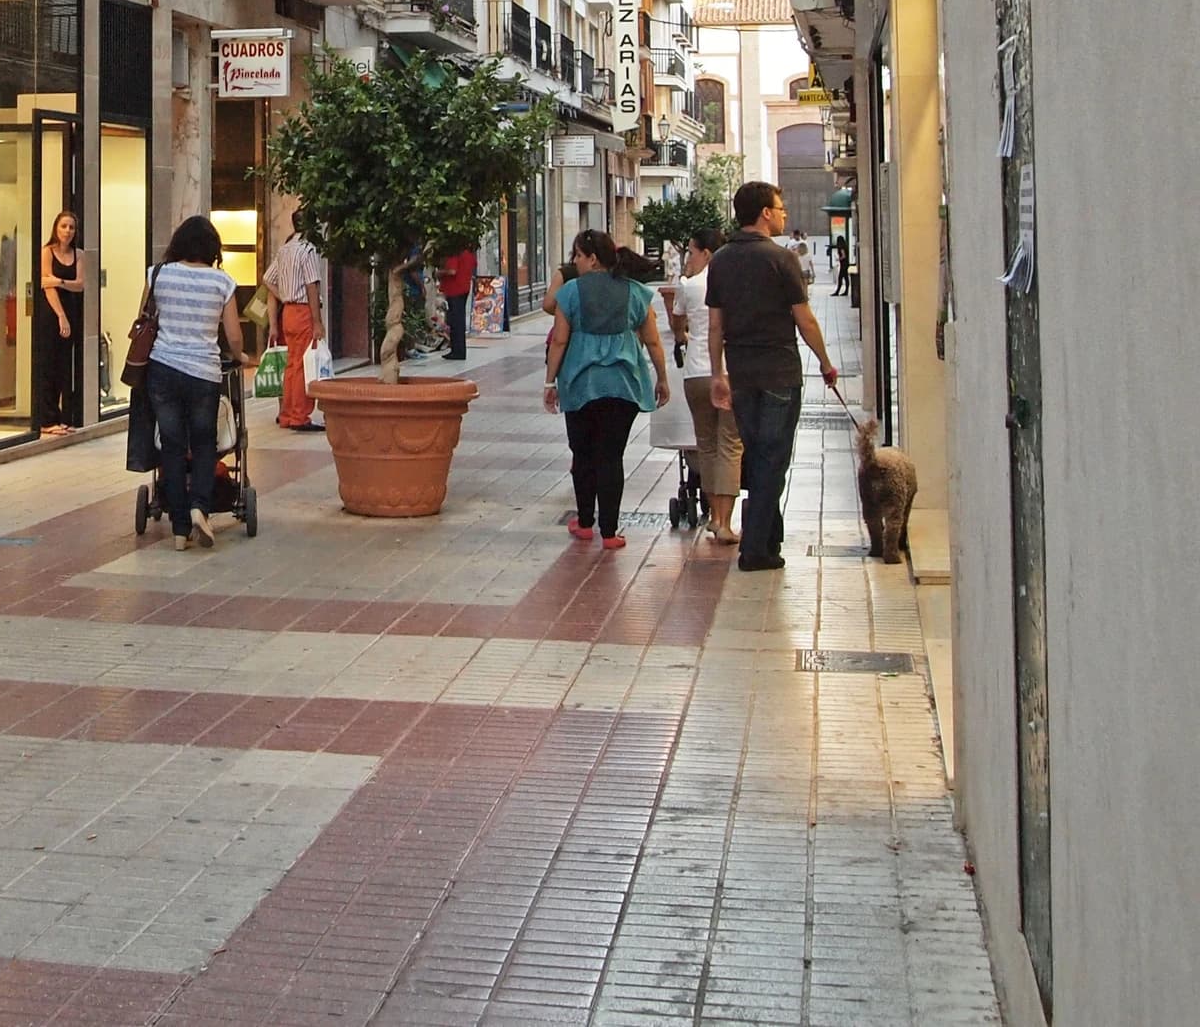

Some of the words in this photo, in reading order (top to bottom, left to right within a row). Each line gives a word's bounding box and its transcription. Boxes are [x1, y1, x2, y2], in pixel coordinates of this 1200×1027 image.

[221, 42, 284, 58] CUADROS
[230, 68, 281, 82] Pincelada
[619, 34, 636, 113] ARIAS
